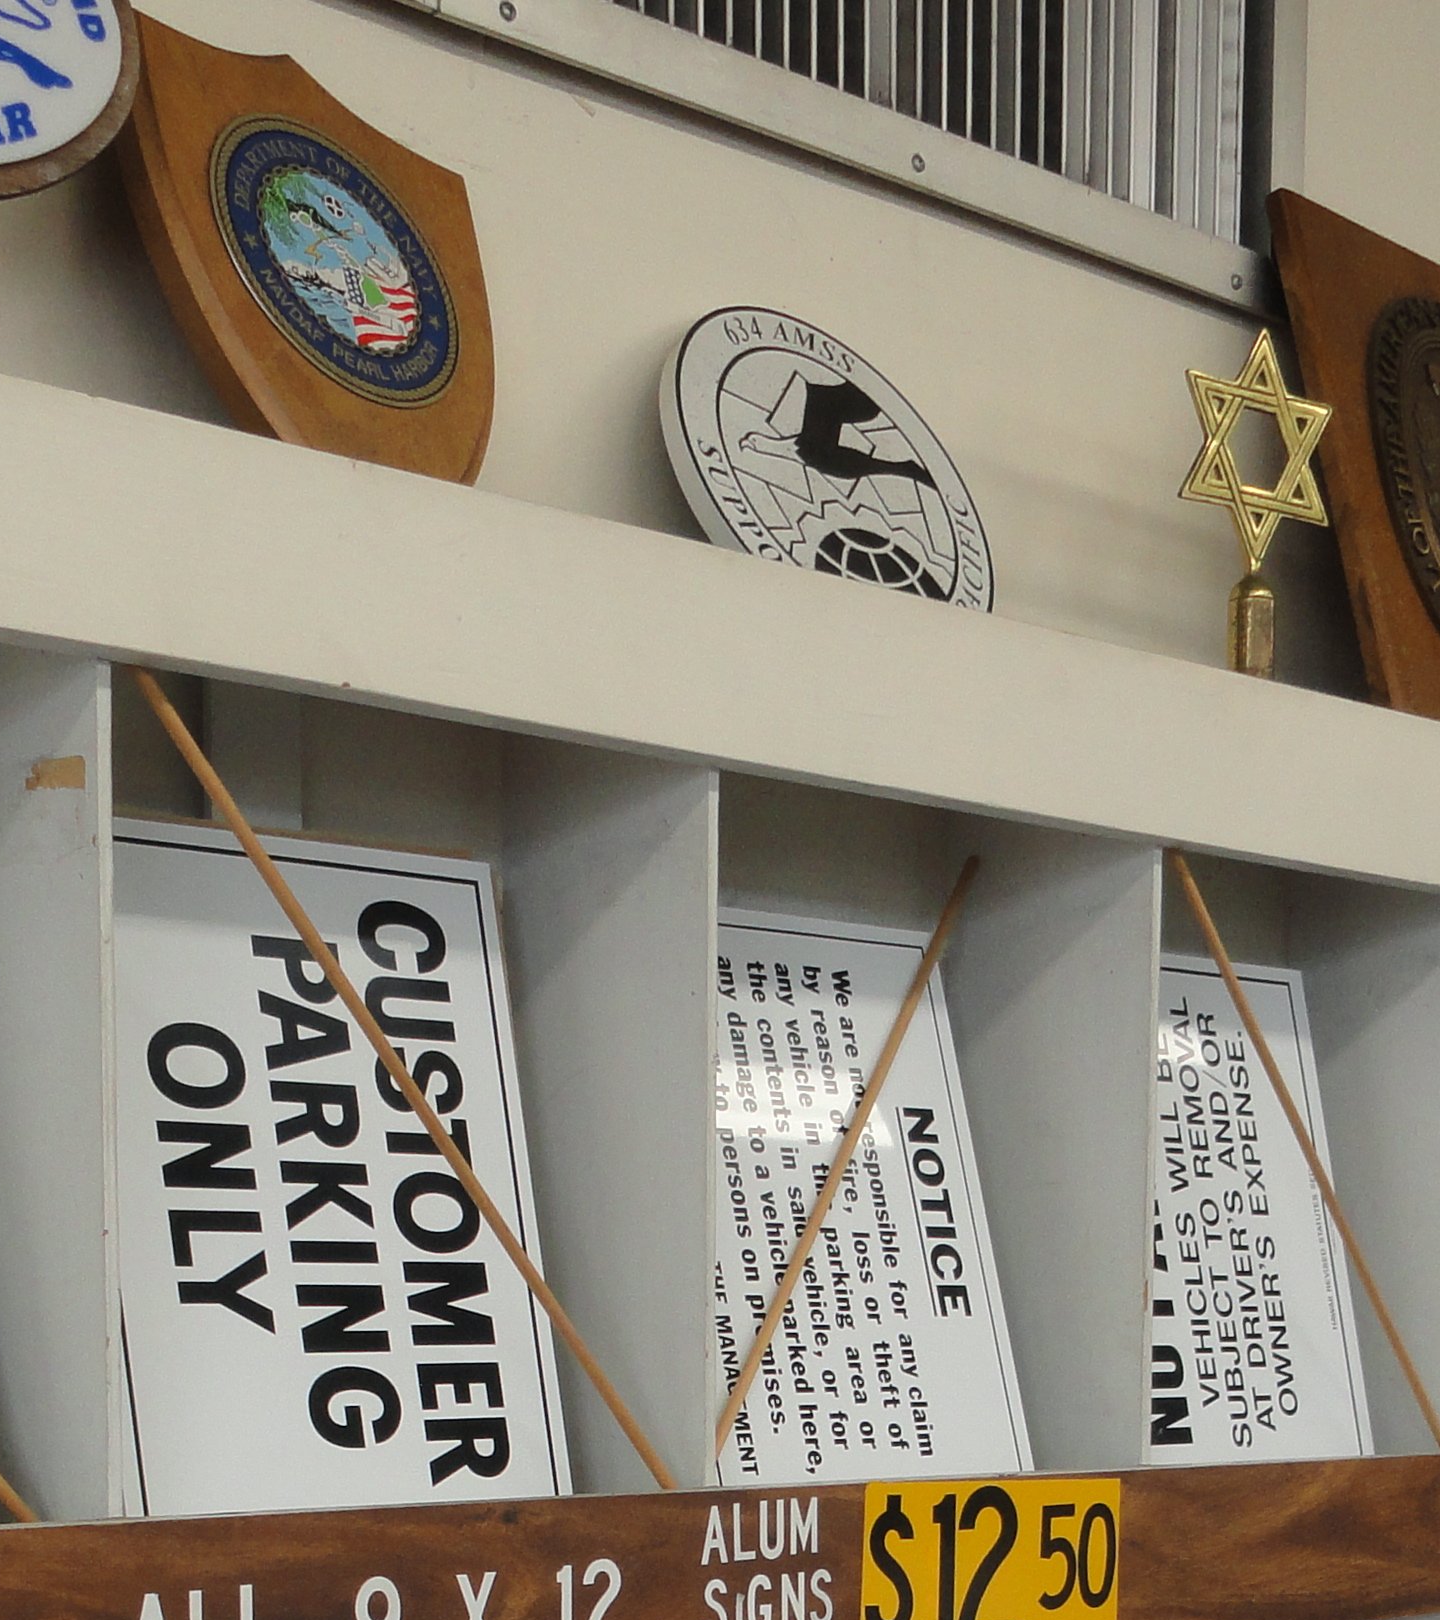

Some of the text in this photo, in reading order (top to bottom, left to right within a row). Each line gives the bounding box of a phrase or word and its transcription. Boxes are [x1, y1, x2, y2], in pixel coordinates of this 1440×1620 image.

[332, 343, 391, 381] PEARL
[391, 340, 439, 382] HARBOR
[723, 315, 855, 374] 634 AMSS
[146, 1022, 276, 1335] ONLY
[251, 934, 402, 1449] PARKING
[357, 900, 511, 1487] CUSTOMER
[819, 1226, 855, 1330] parking
[902, 1105, 972, 1318] NOTICE
[1161, 1106, 1221, 1408] VEHICLES WILL
[1169, 996, 1253, 1449] SUBJECT TO REMOVAL
[1196, 1011, 1277, 1433] AT DRIVER'S AND/OR
[1224, 1029, 1300, 1418] OWNER'S EXPENSE.
[700, 1496, 819, 1566] ALUM
